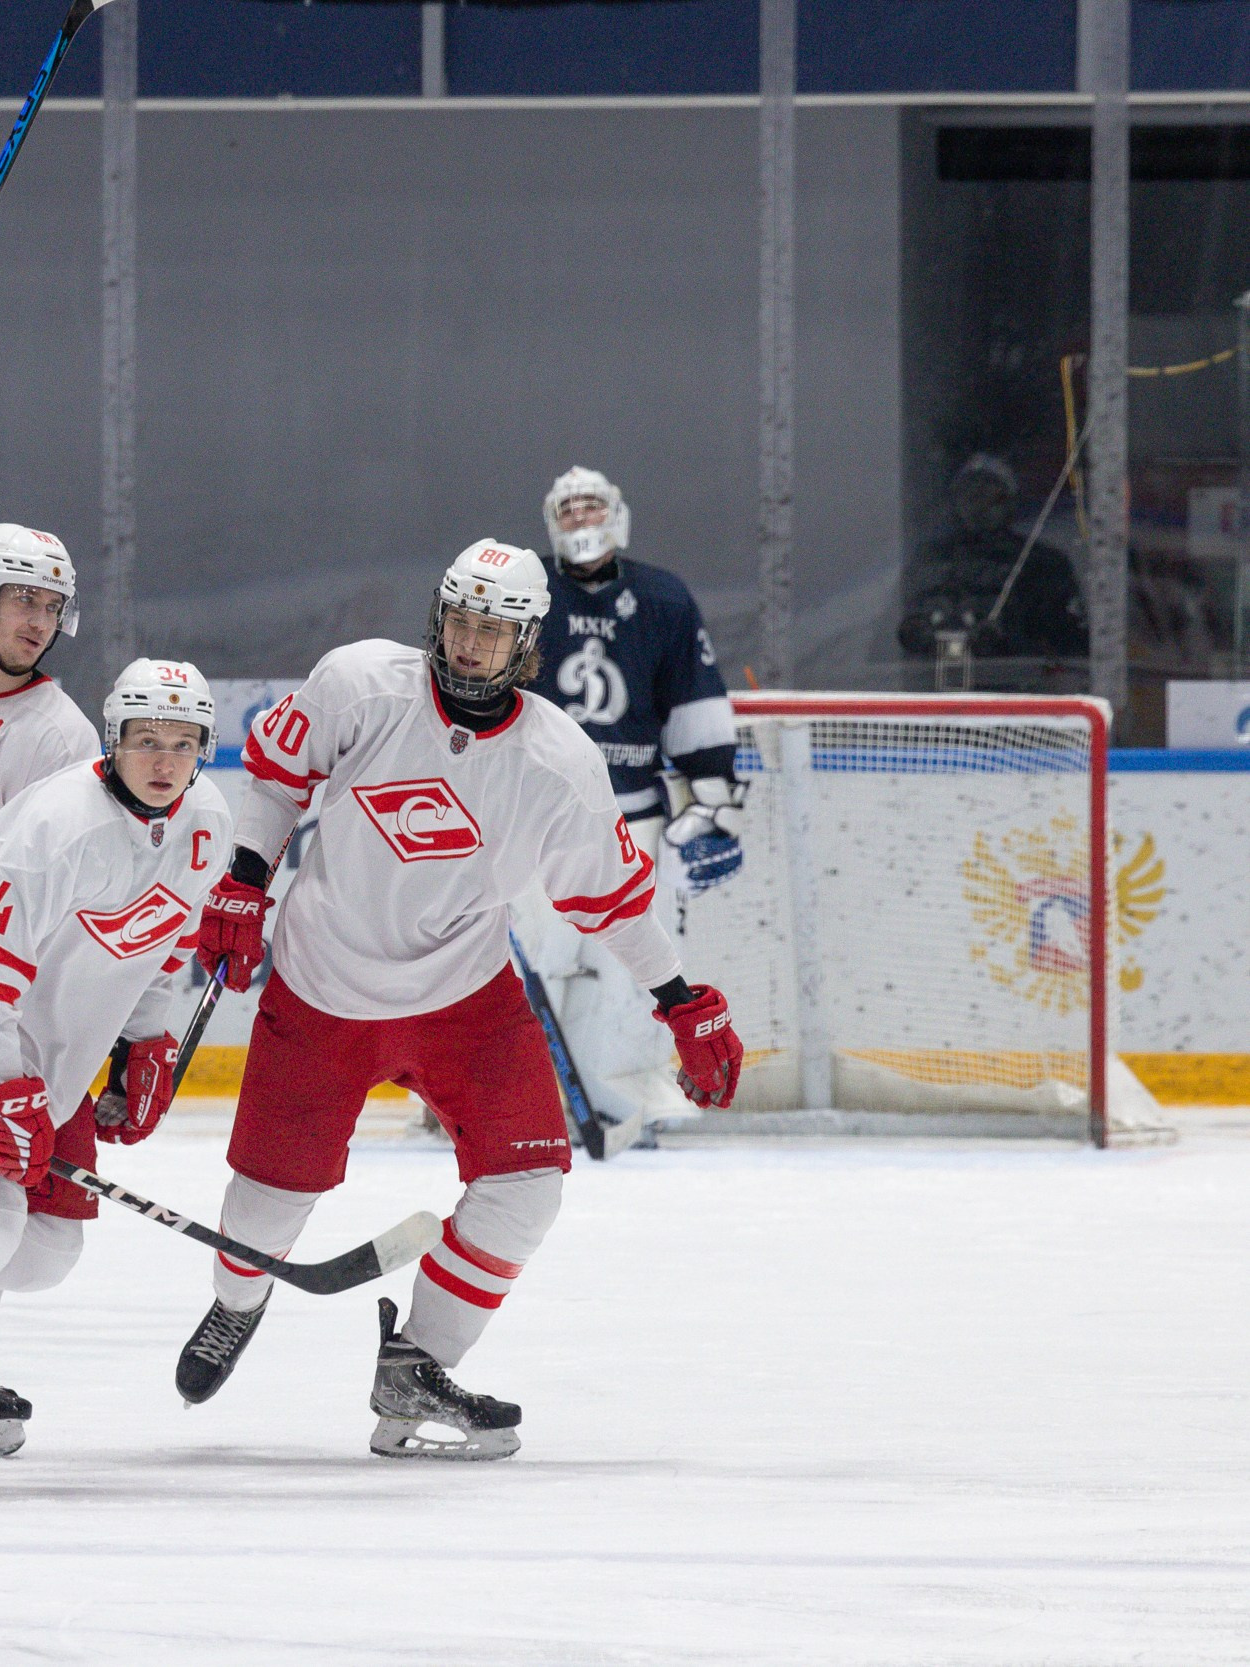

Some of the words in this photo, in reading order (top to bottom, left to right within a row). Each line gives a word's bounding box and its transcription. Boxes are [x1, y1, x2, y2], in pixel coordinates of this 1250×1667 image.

[478, 549, 511, 568] 80
[41, 576, 68, 587] OLIMPBET
[462, 593, 494, 606] OLIMPBET
[157, 667, 188, 683] 34
[157, 704, 191, 713] OLIMPBET
[263, 694, 311, 757] 80
[190, 829, 212, 872] C
[510, 1138, 568, 1150] TRUE
[70, 1168, 193, 1233] CCM
